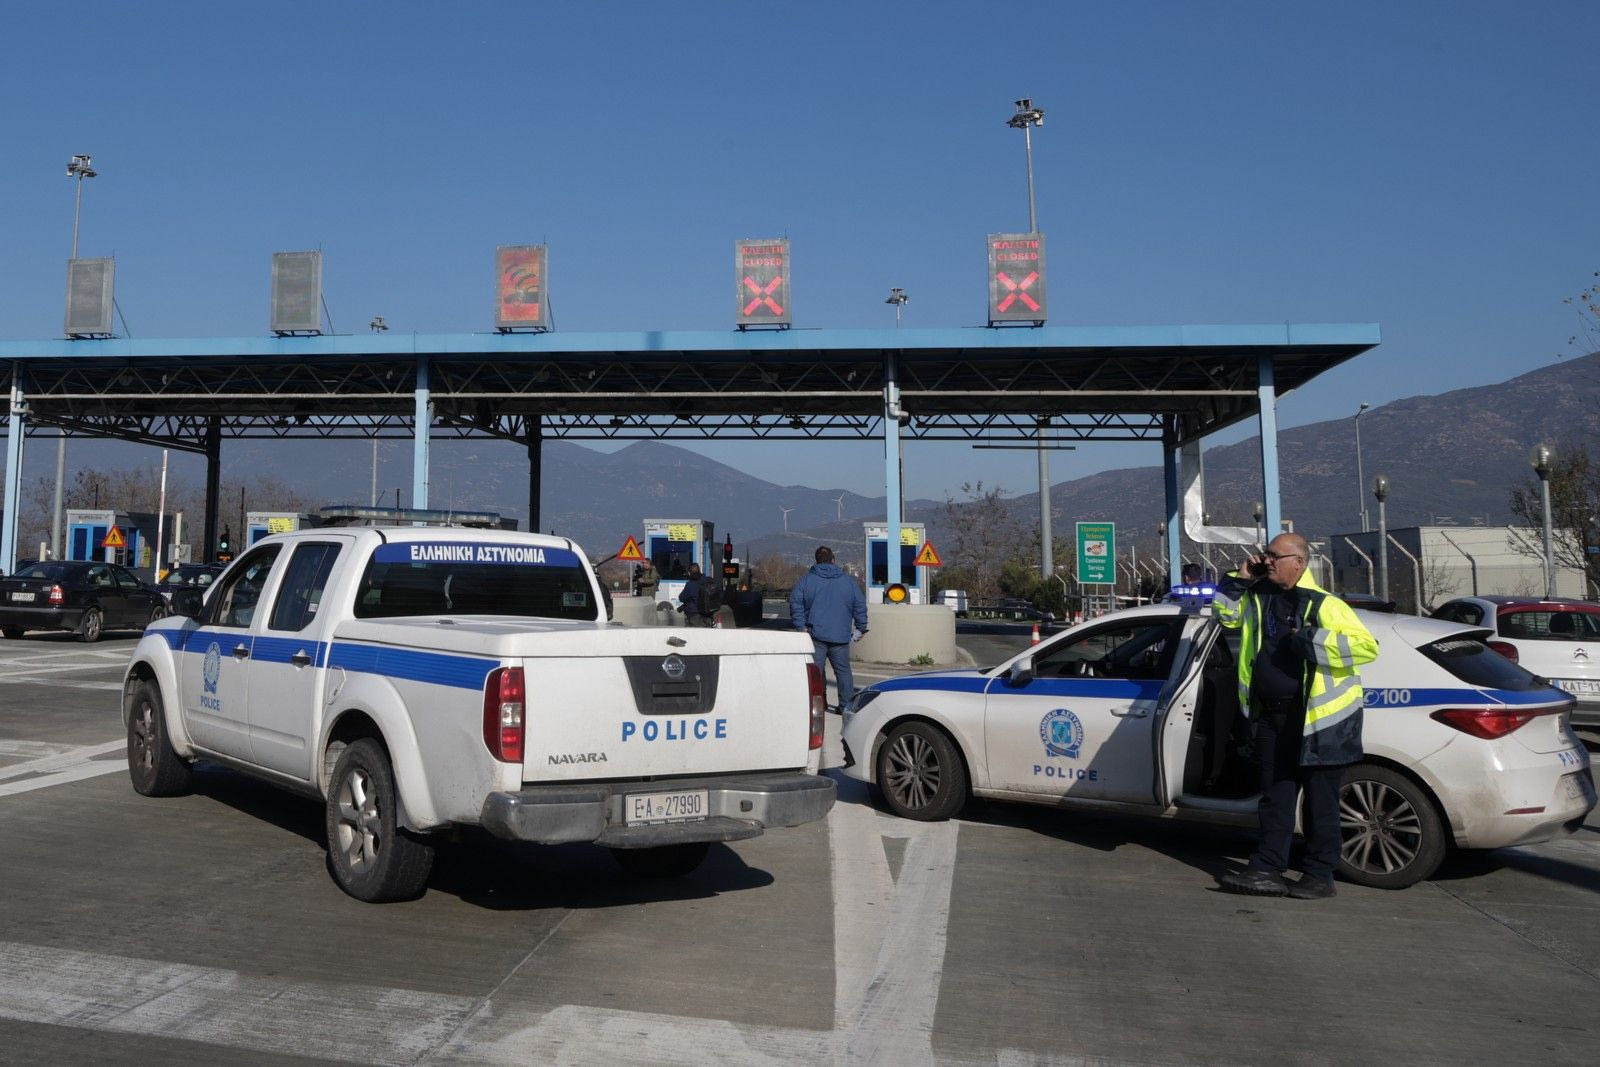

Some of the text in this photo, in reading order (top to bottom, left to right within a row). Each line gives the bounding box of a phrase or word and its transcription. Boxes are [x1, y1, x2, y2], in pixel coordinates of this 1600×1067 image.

[411, 545, 546, 564] ΕΛΛΗΝΙΚΗ ΑΣΤΥΝΟΜΙΑ
[200, 695, 221, 711] POLICE
[1380, 689, 1412, 705] 100
[622, 719, 728, 742] POLICE
[548, 752, 608, 765] NAVARA
[1033, 765, 1098, 781] POLICE
[665, 795, 701, 816] 27990
